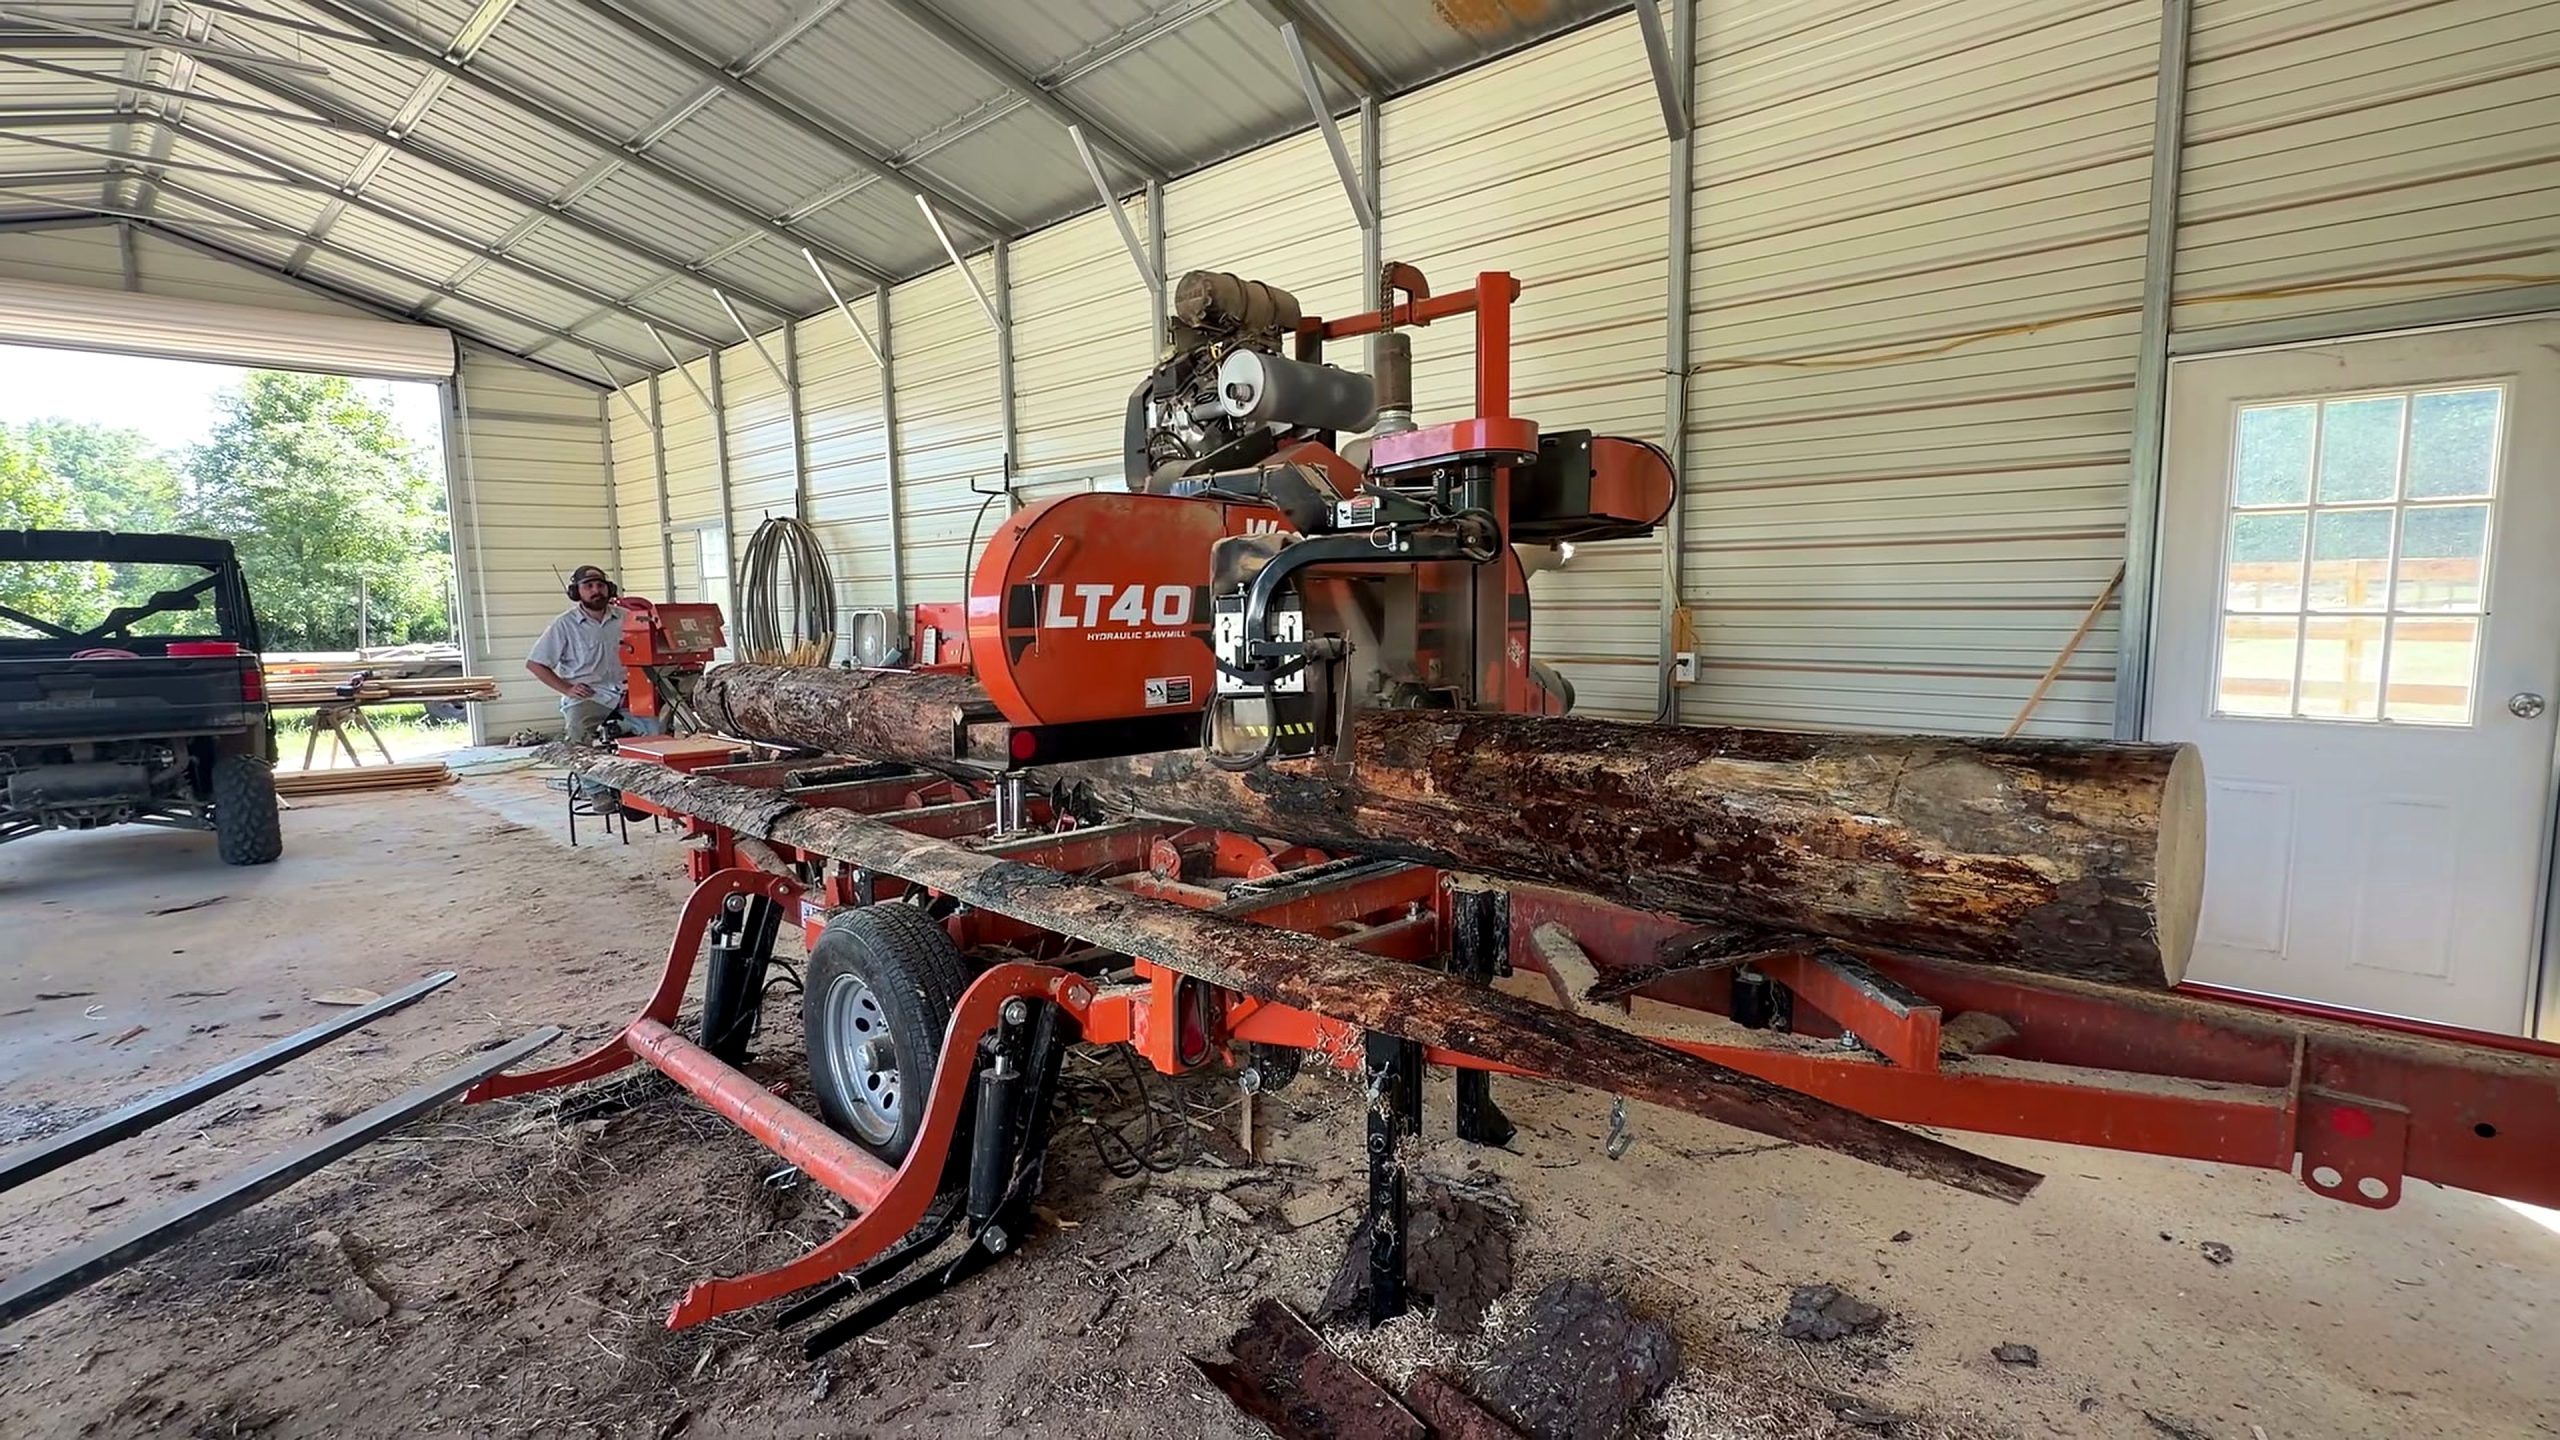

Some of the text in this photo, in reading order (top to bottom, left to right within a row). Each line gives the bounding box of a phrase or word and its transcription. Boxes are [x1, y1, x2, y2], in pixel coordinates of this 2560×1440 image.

[1045, 584, 1191, 628] LT40
[1087, 630, 1187, 641] HYDRAULIC SAWMILL
